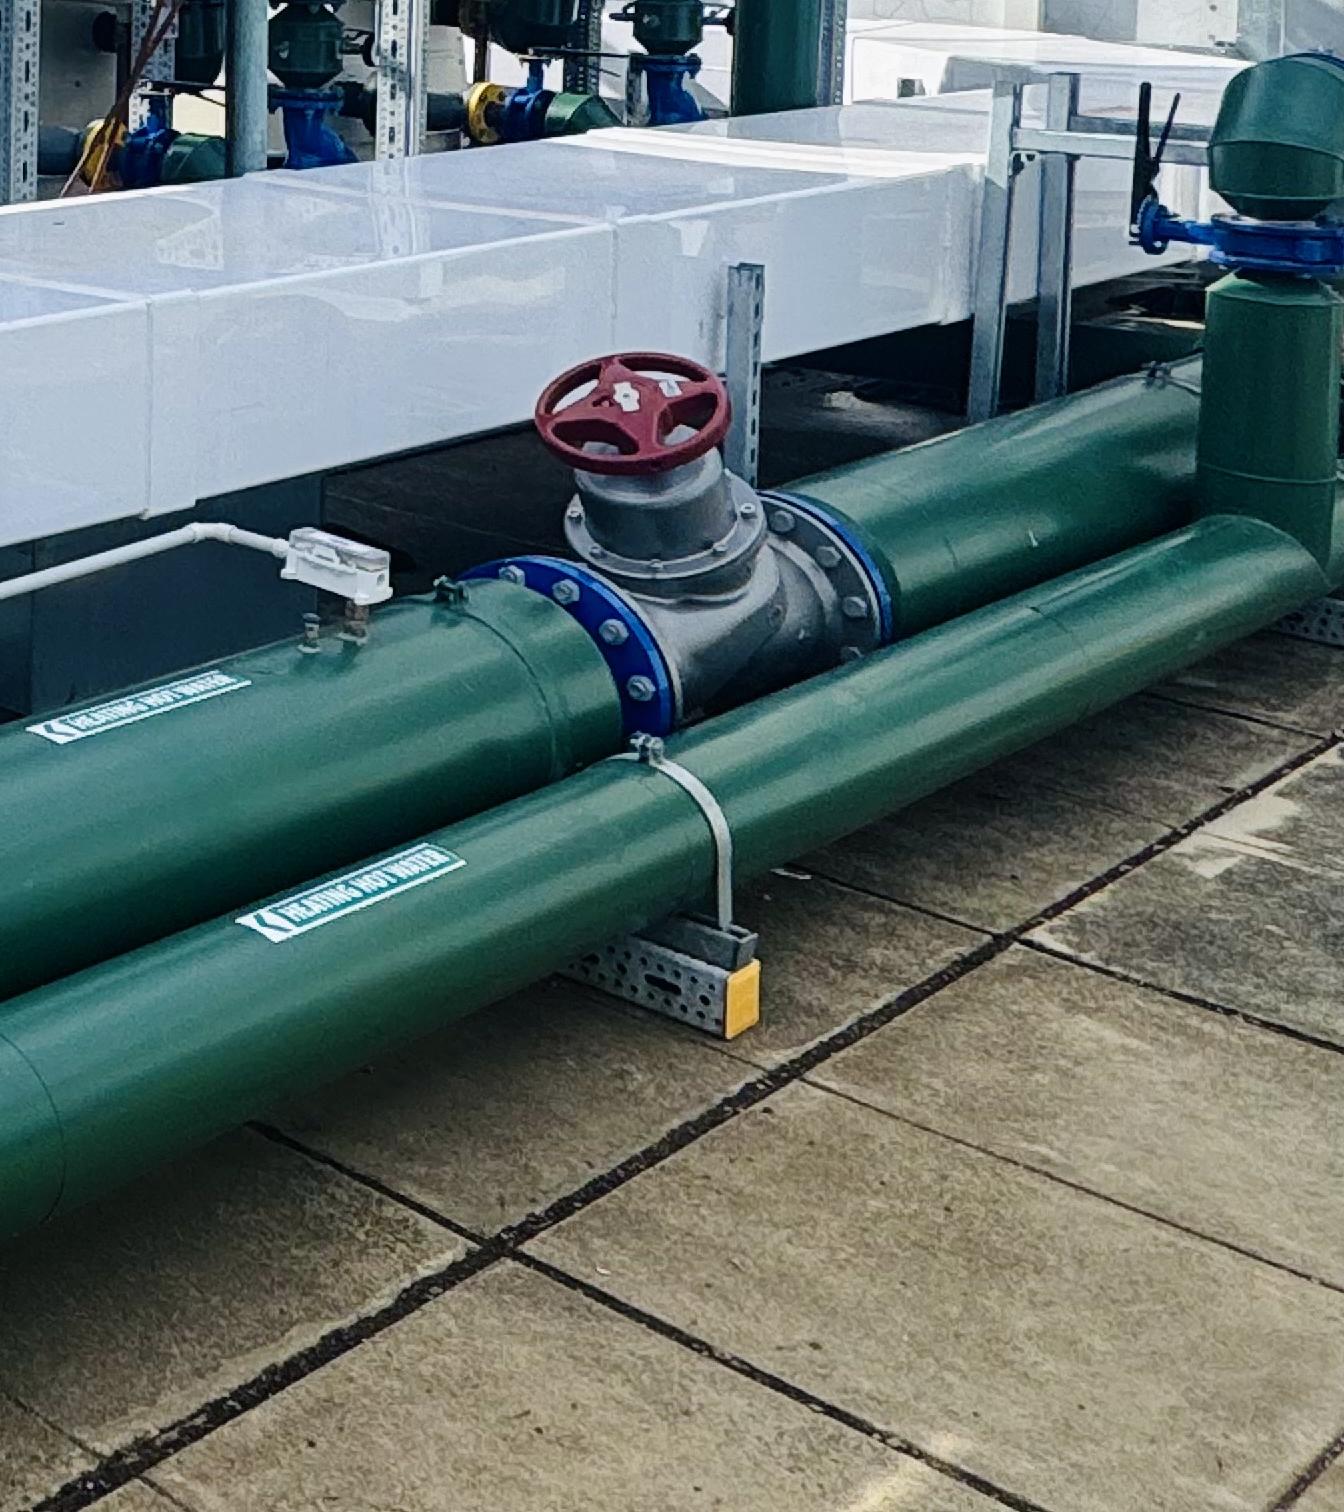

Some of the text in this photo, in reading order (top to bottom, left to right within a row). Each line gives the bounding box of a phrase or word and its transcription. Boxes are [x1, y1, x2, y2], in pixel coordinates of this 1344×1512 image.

[68, 699, 150, 730] HEATING
[276, 848, 451, 923] HEATING HOT WATER
